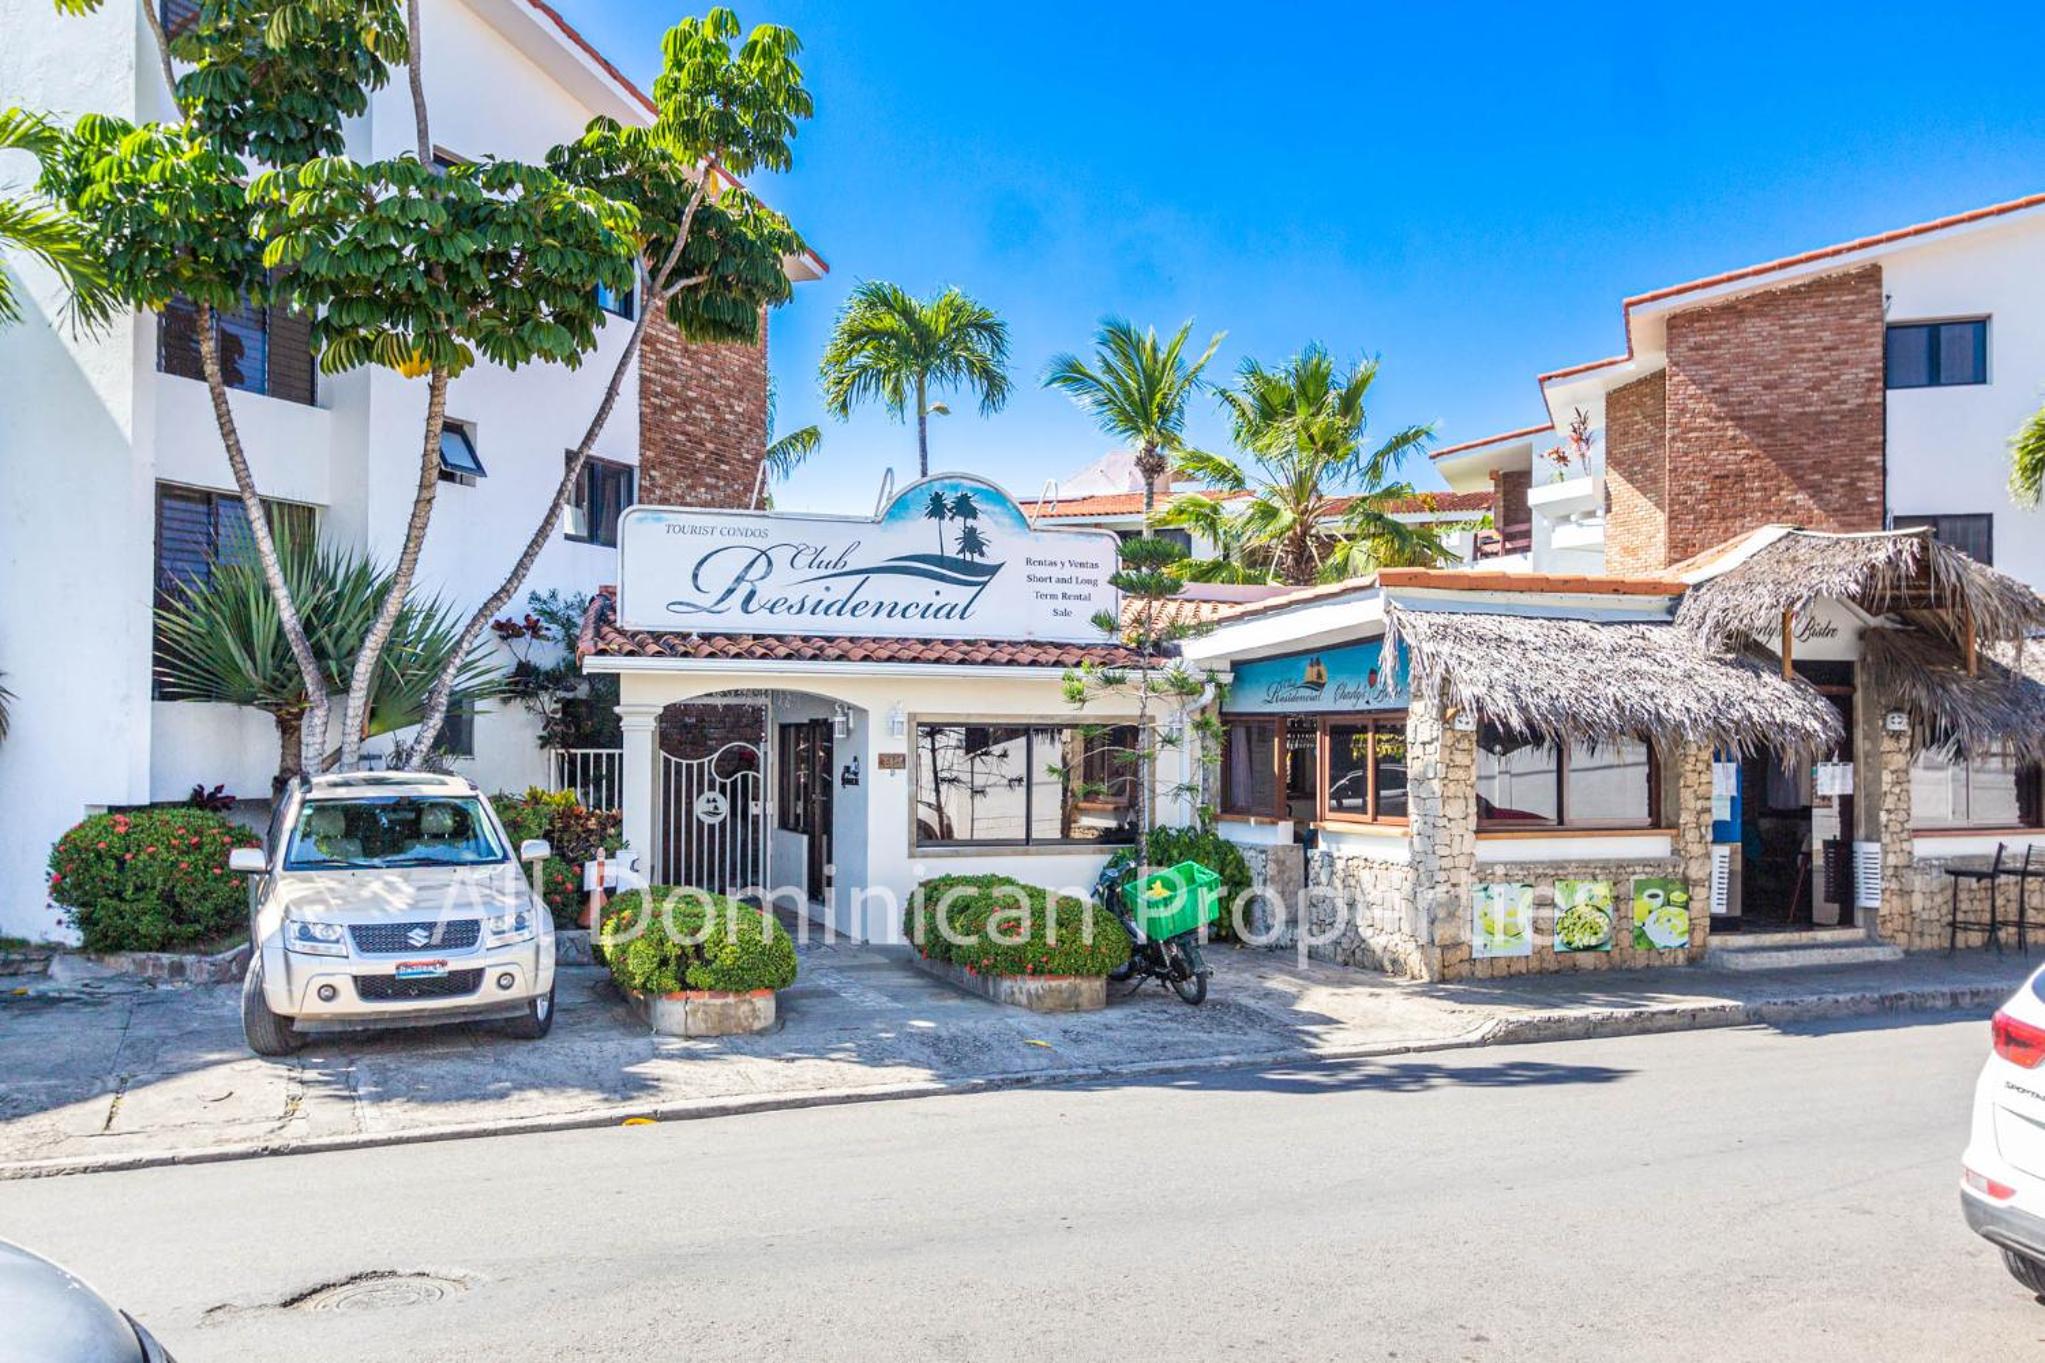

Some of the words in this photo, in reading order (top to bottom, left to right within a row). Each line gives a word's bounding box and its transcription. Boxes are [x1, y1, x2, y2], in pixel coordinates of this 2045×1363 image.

[665, 523, 717, 536] TOURIST
[720, 526, 769, 539] CONDOS
[790, 541, 860, 570] Club
[1025, 557, 1058, 567] Rentas
[1060, 559, 1066, 570] y
[1068, 559, 1100, 569] Ventas
[666, 544, 1004, 621] Residencial
[1026, 574, 1053, 583] Short
[1055, 575, 1073, 585] and
[1075, 576, 1099, 588] Long
[1035, 591, 1059, 601] Term
[1061, 592, 1092, 602] Rental
[1052, 607, 1073, 617] Sale
[1793, 609, 1839, 643] Bistro
